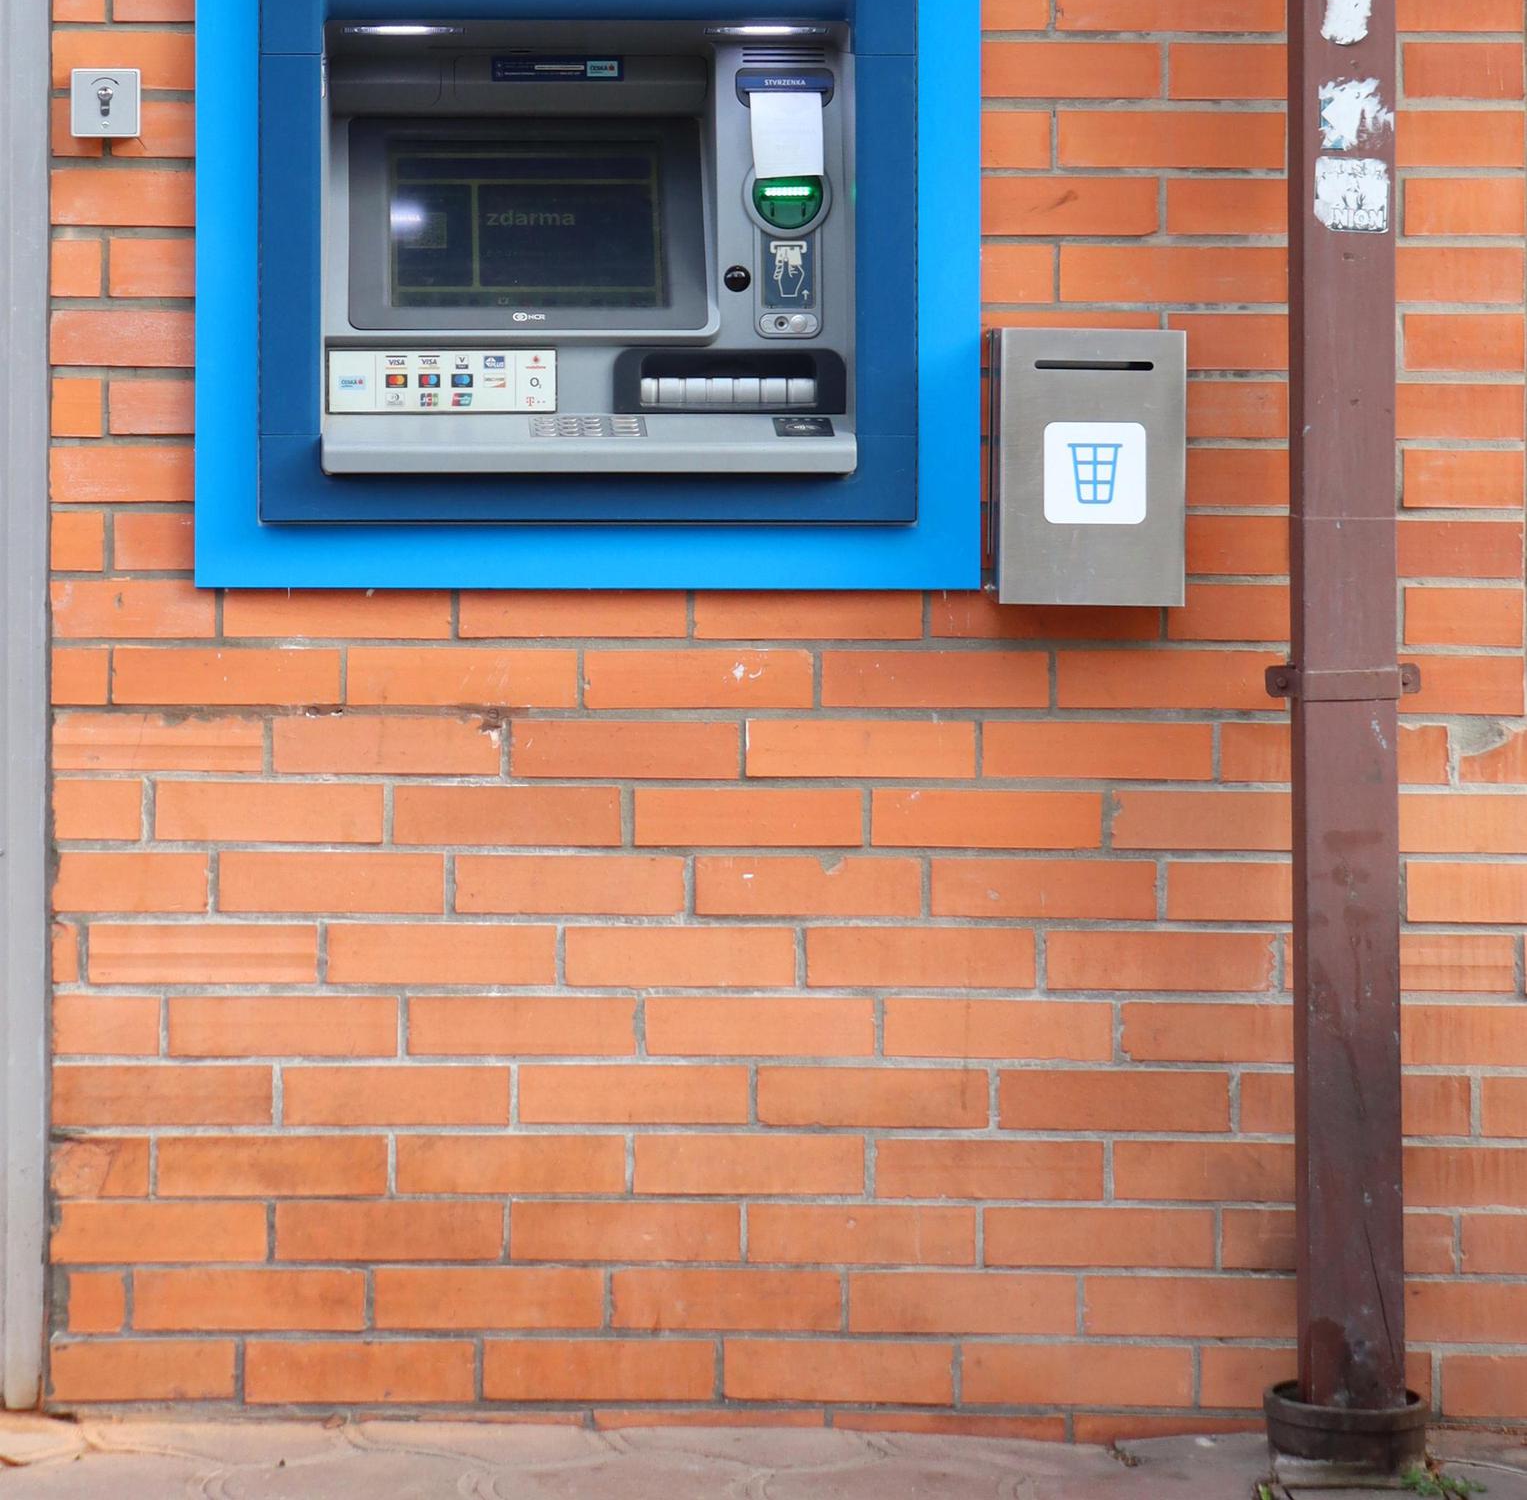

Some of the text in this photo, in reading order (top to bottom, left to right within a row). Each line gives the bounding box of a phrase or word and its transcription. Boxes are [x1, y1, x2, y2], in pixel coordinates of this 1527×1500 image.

[486, 209, 576, 226] zdarma
[388, 358, 406, 366] VISA
[421, 358, 438, 366] VISA
